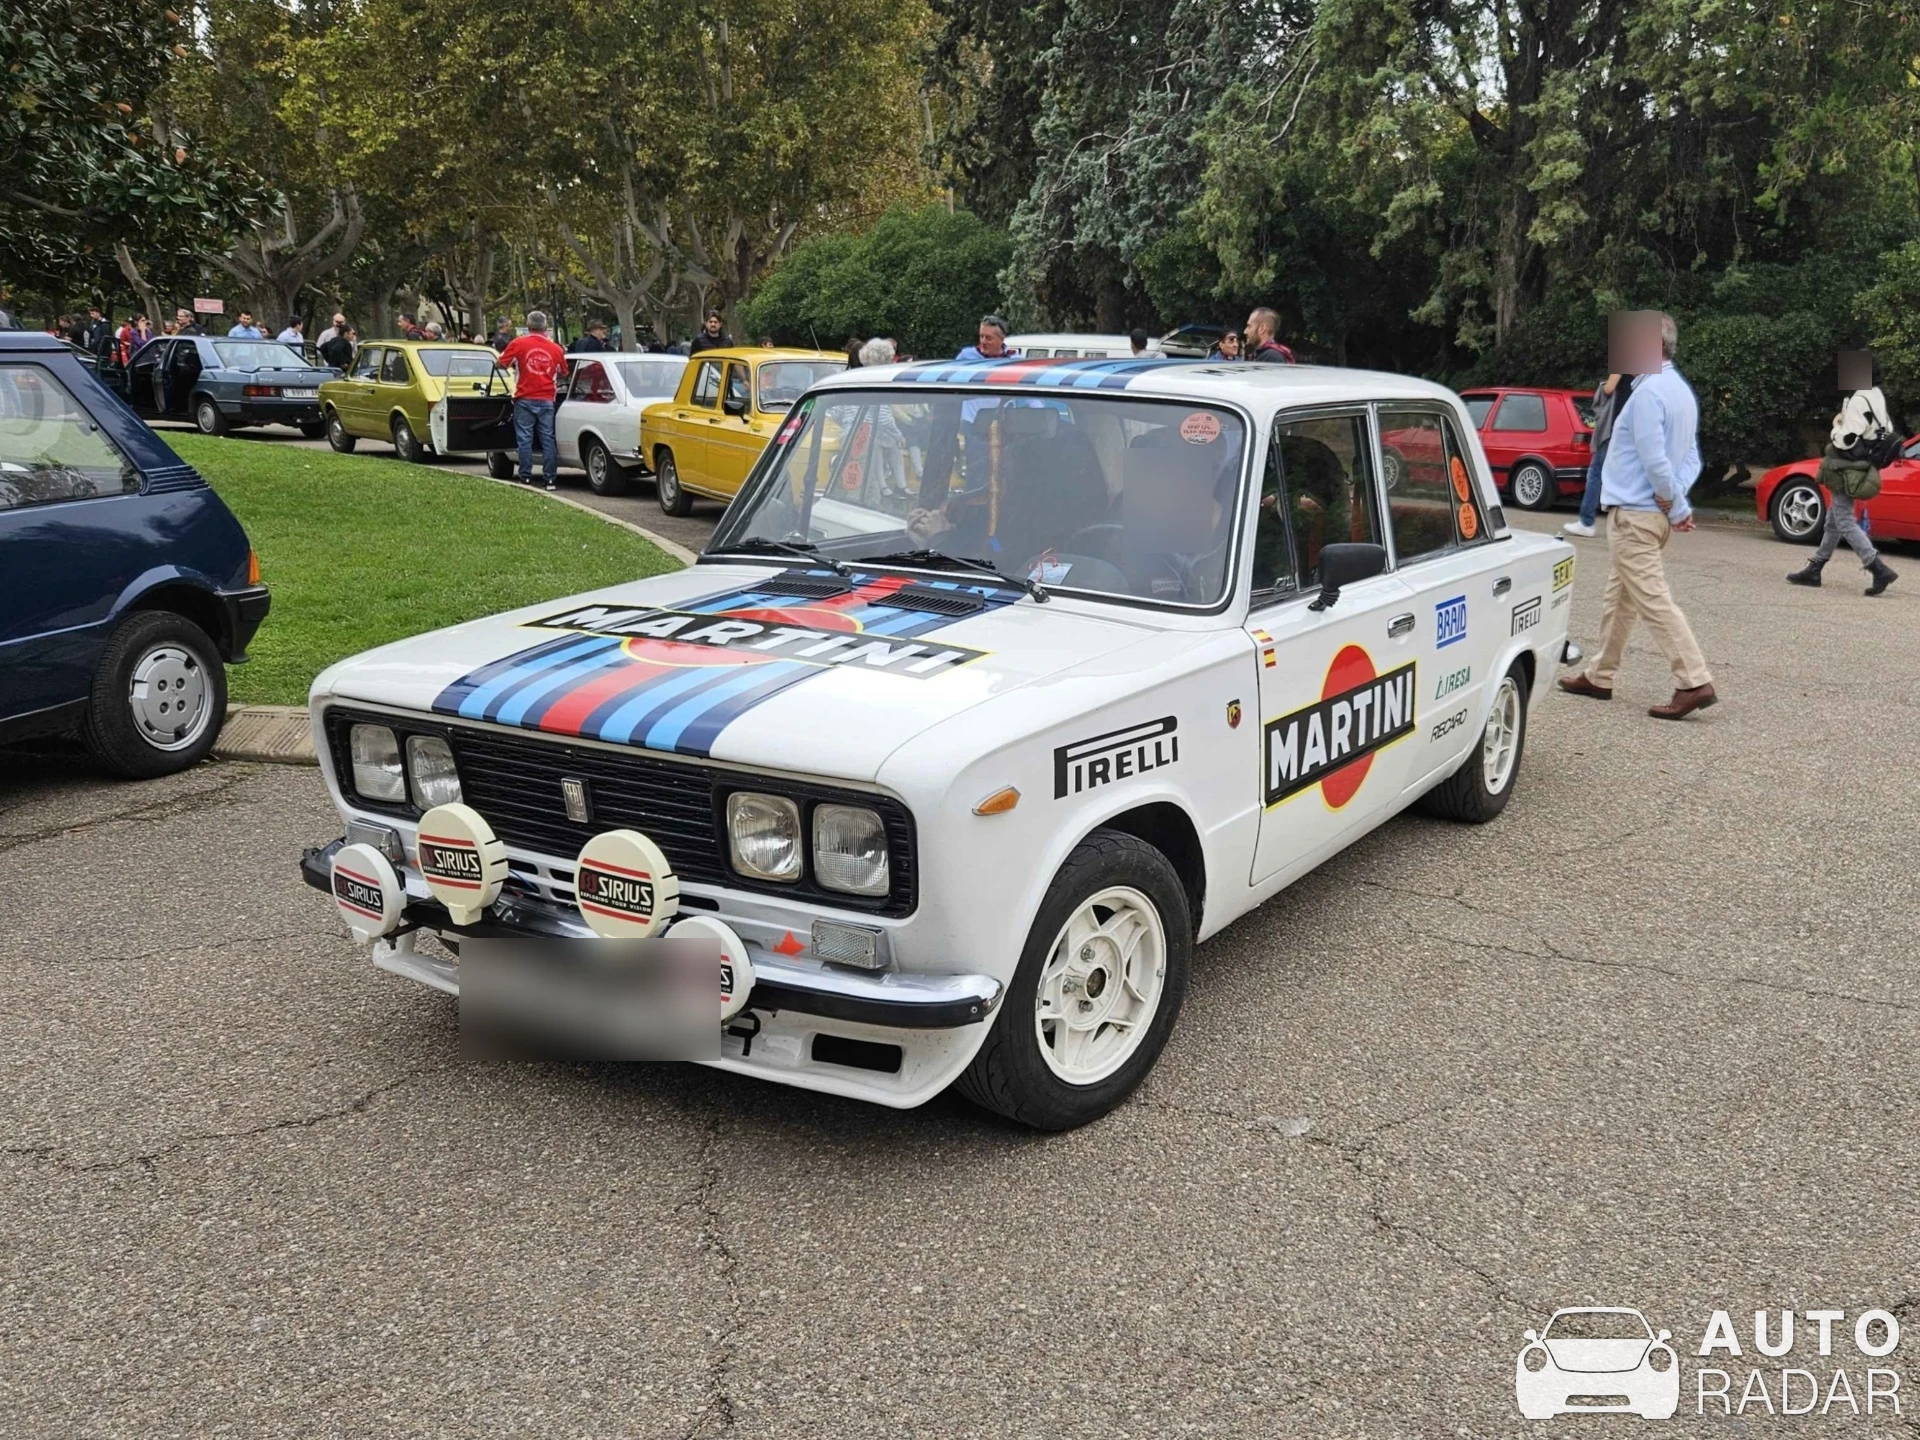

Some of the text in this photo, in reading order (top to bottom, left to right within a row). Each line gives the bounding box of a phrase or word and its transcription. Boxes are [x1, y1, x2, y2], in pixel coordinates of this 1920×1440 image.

[1436, 603, 1467, 642] BRAID
[1511, 595, 1541, 637] PIRELLI
[545, 606, 966, 675] MARTINI
[1270, 670, 1414, 791] MARTINI
[1430, 708, 1468, 743] RECARO
[1053, 715, 1178, 800] PIRELLI
[434, 849, 480, 873] SIRIUS
[347, 881, 382, 907] SIRIUS
[580, 891, 652, 913] EXPLORING YOUR VISION
[598, 876, 652, 907] SIRIUS
